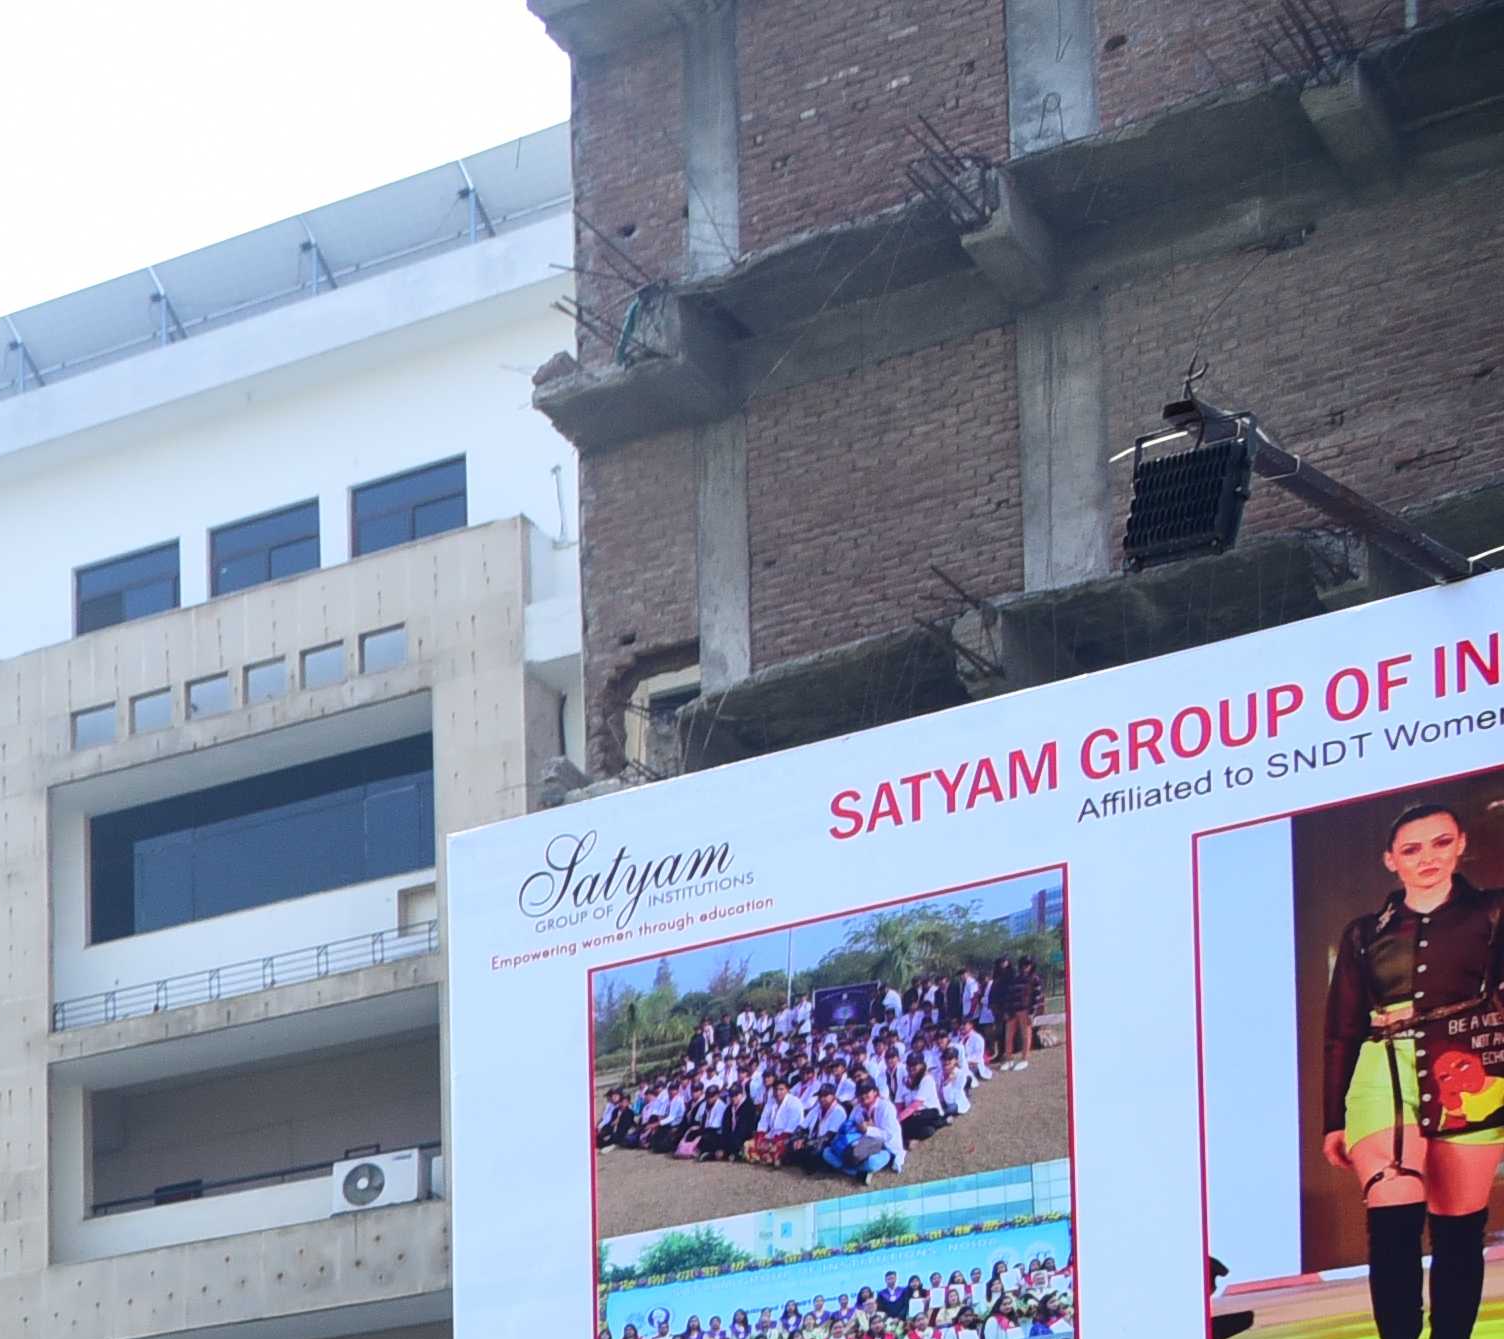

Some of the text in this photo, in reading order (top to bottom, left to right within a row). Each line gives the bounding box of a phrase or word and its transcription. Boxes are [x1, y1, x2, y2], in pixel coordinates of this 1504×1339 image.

[828, 741, 1059, 840] SATYAM
[1080, 683, 1304, 780] GROUP
[1325, 653, 1413, 722] OF
[1078, 767, 1213, 823] Affiliated
[1224, 763, 1254, 788] to
[1266, 733, 1369, 780] SNDT
[519, 830, 734, 930] Satyam
[535, 872, 754, 933] GROUP OF INSTITUTIONS
[491, 898, 774, 970] Empowering women through education
